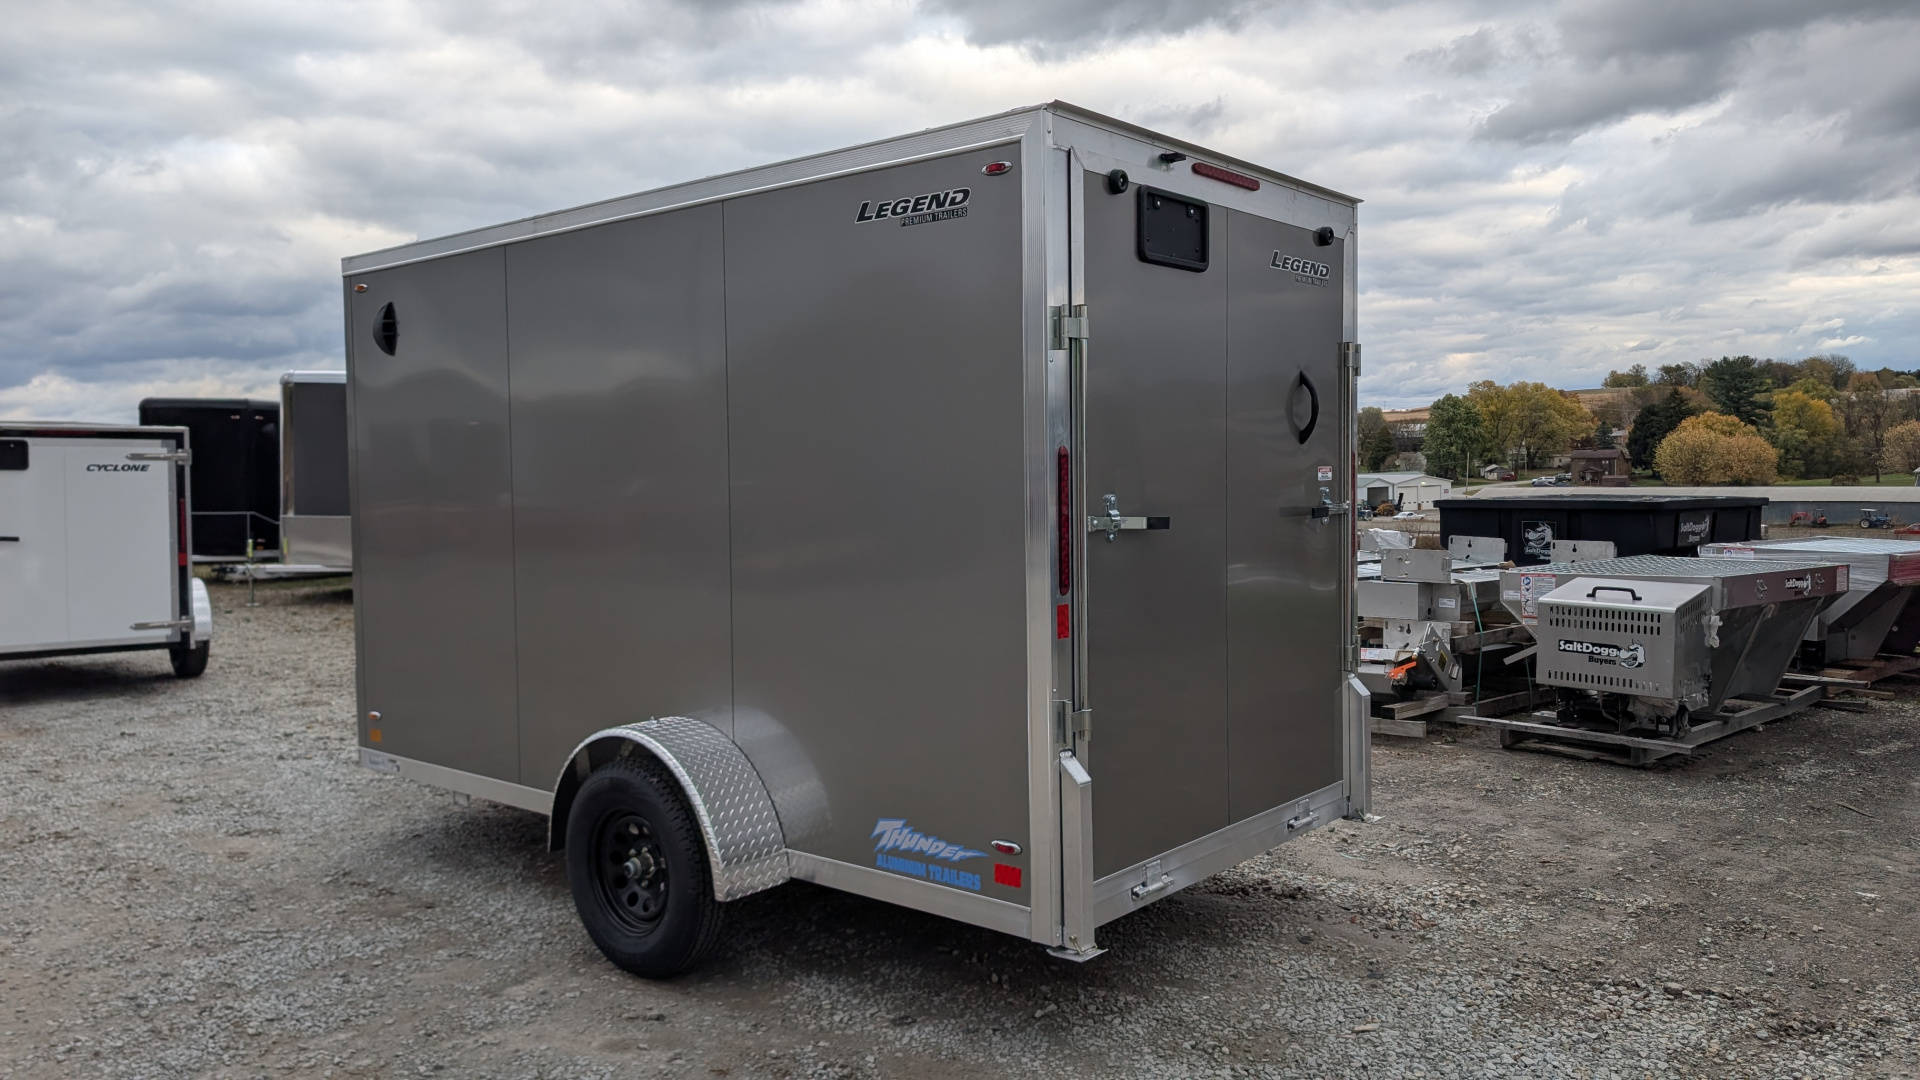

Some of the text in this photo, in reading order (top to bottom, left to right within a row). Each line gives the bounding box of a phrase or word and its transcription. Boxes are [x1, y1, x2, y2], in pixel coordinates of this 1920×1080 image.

[855, 187, 971, 224] LEGEND
[900, 207, 967, 227] PREMIUM TRAILERS
[1270, 249, 1330, 279] LEGEND
[86, 464, 150, 472] CYCLONE
[1559, 640, 1617, 657] SaltDogg
[1588, 655, 1617, 665] Buyers
[876, 853, 981, 891] ALUMINUM TRAILERS
